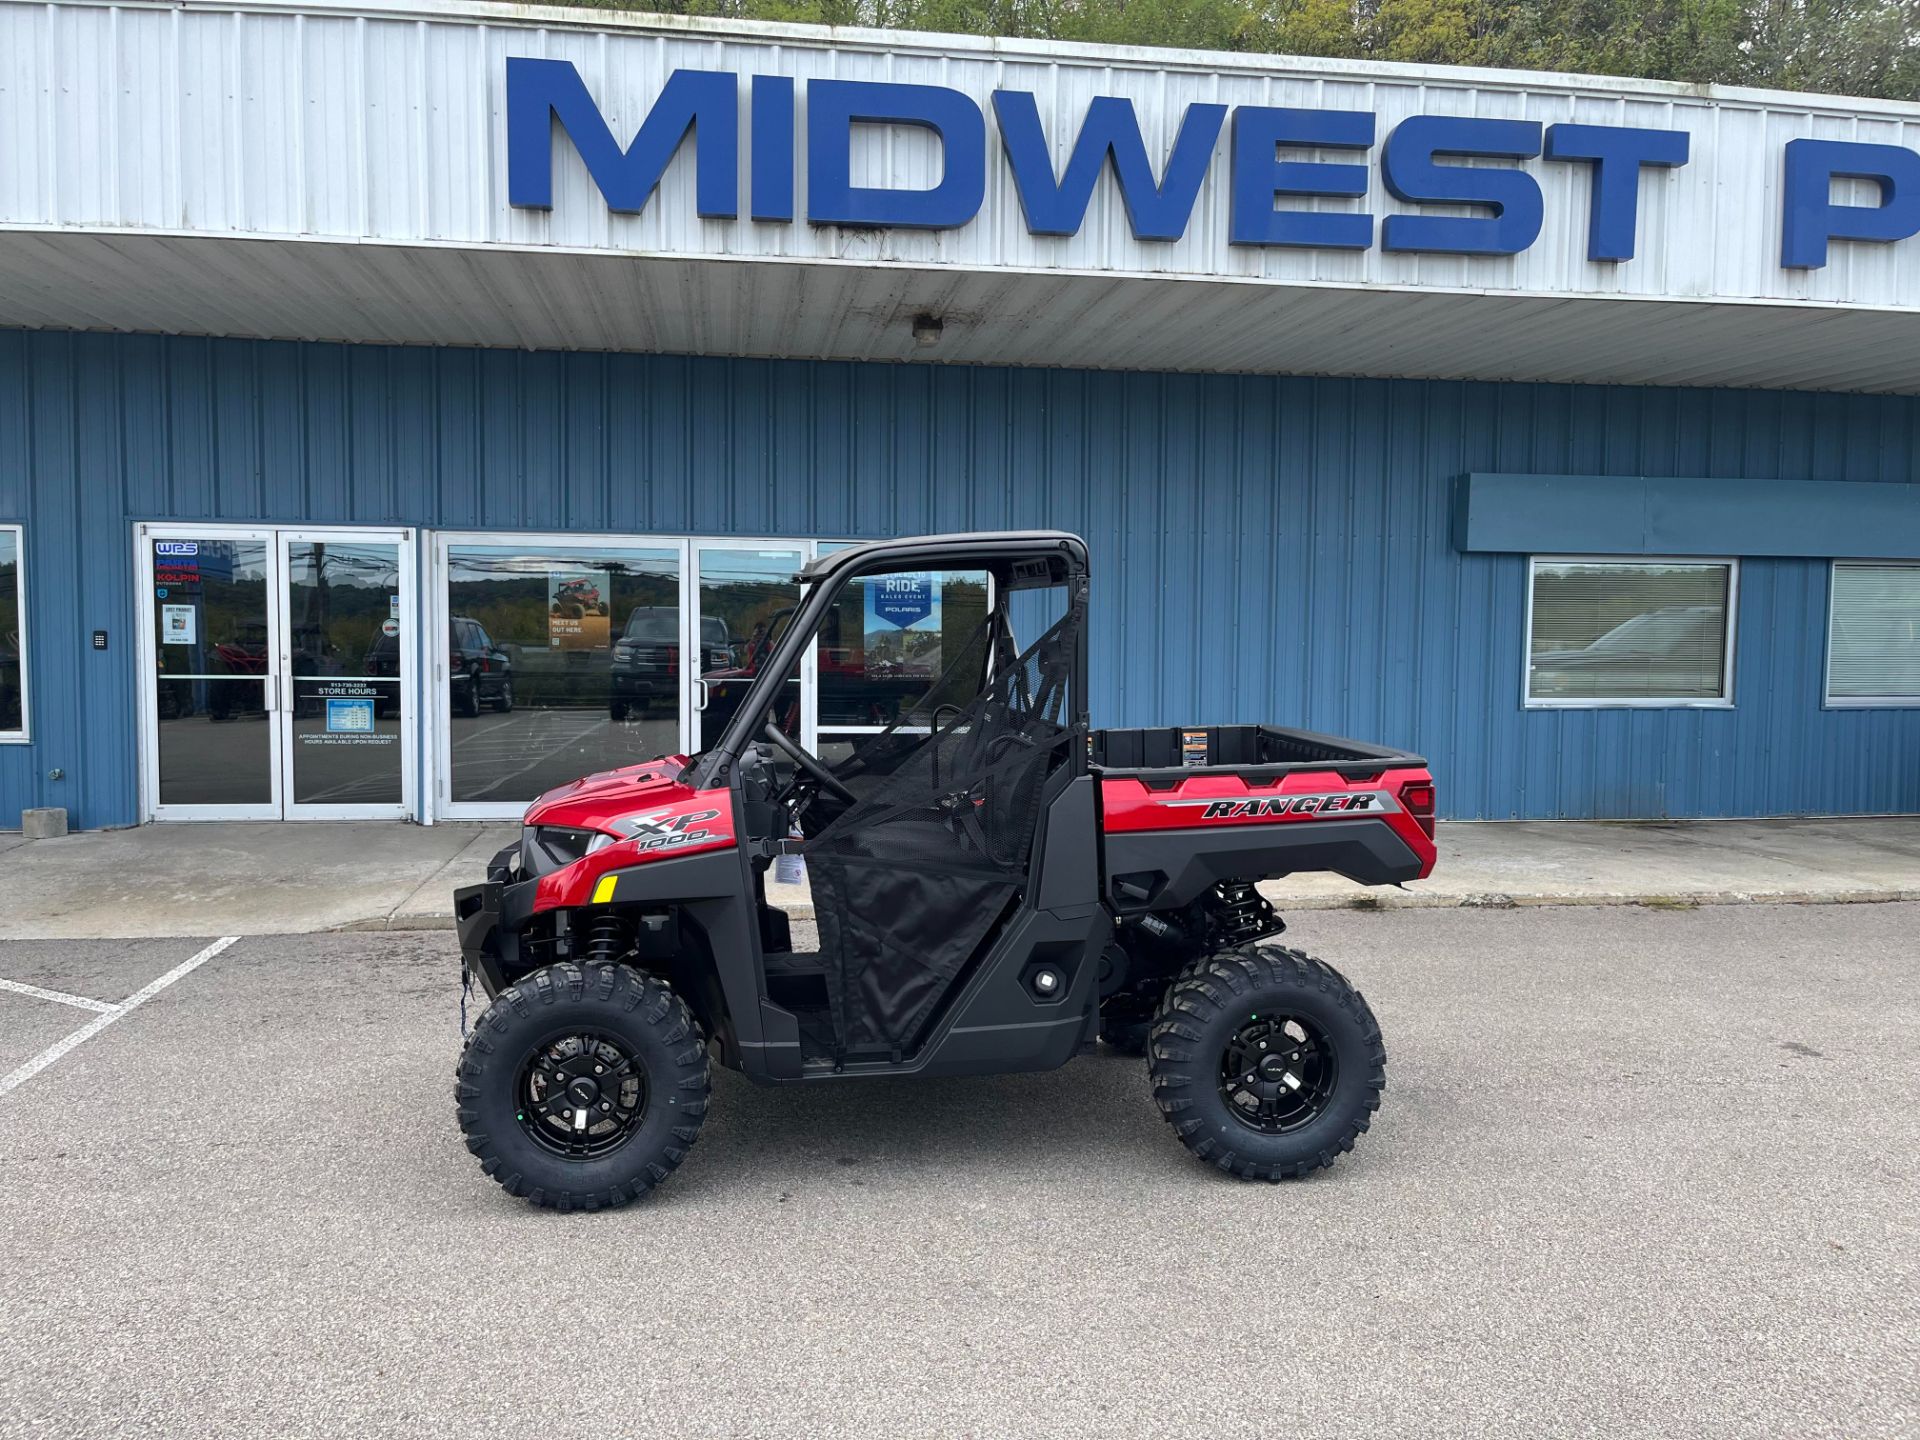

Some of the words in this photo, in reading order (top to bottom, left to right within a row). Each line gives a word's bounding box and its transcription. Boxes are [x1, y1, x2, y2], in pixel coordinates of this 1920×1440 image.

[506, 57, 1689, 263] MIDWEST
[157, 543, 198, 555] WPS
[156, 573, 200, 582] KOLPIN
[886, 579, 920, 592] RIDE
[318, 687, 347, 695] STORE
[1202, 793, 1376, 819] RANGER
[623, 809, 720, 841] XP
[638, 829, 709, 852] 1000
